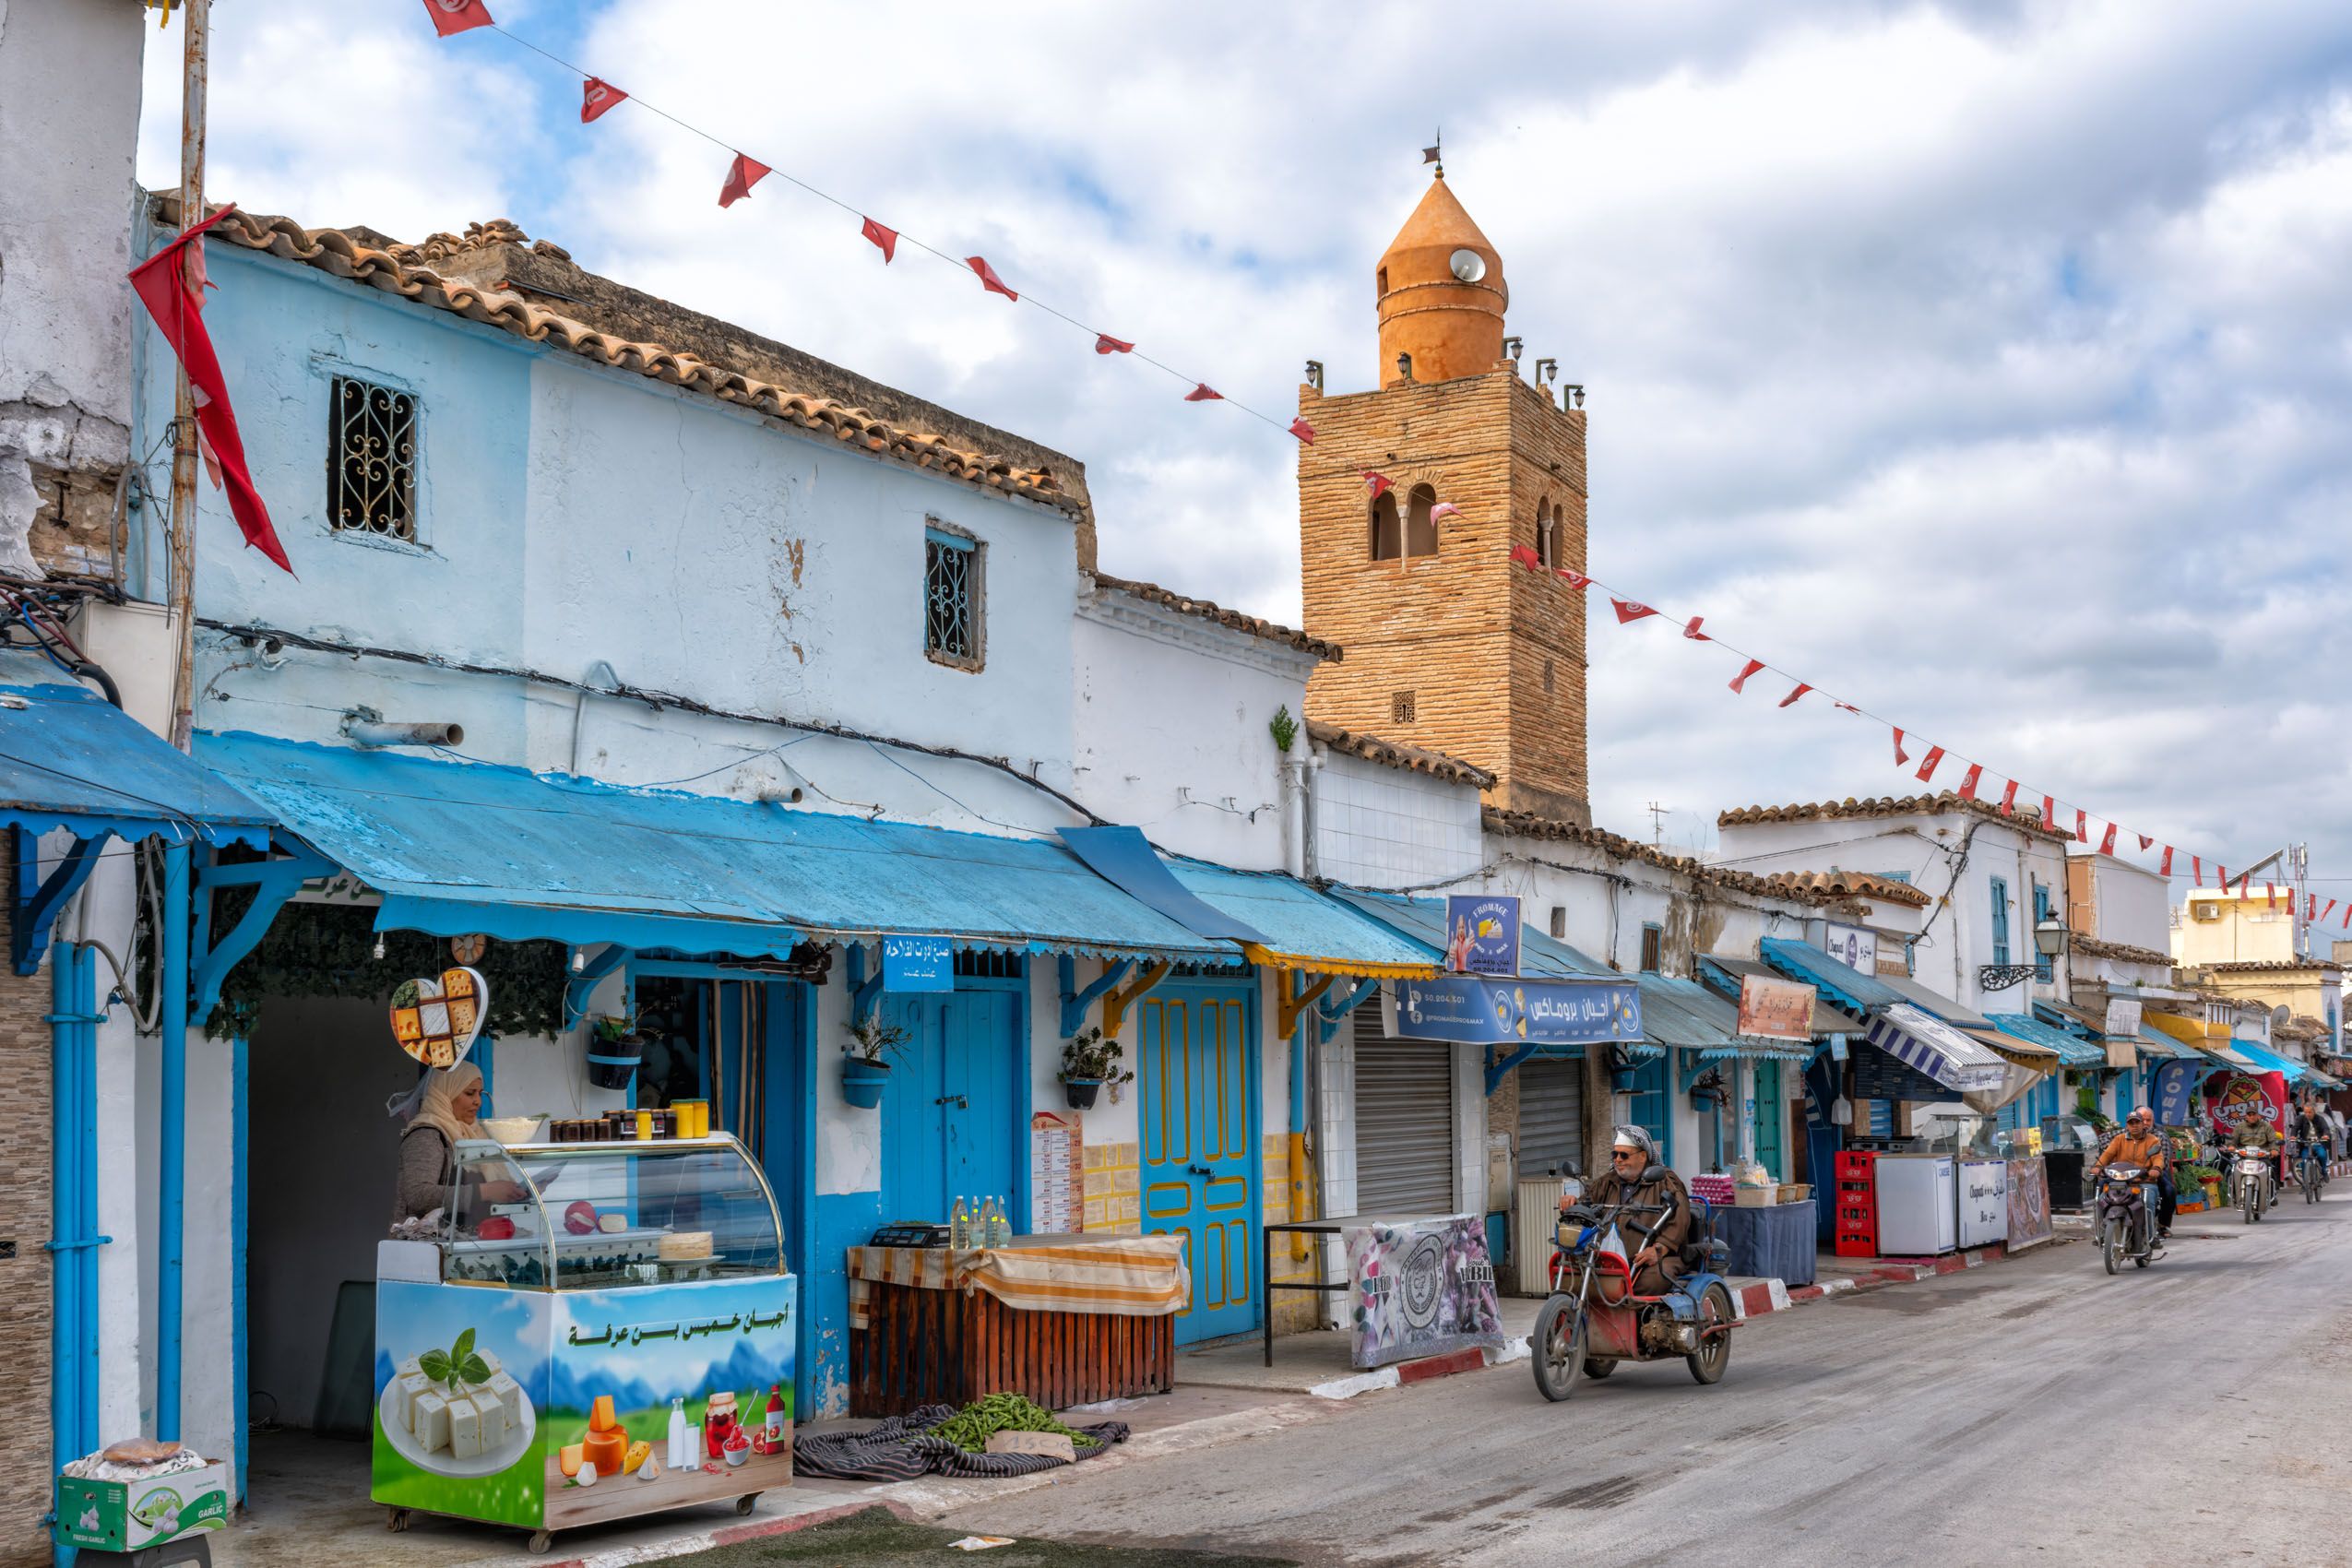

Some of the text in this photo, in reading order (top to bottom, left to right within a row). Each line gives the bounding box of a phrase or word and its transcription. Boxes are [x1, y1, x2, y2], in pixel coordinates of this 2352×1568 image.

[1473, 903, 1509, 918] FROMAGE
[1475, 943, 1485, 954] PRO
[1496, 943, 1509, 955] MAX
[1425, 994, 1465, 1004] 50.204401
[1530, 992, 1609, 1021] أجبان بروماكس
[568, 1302, 789, 1348] أجبان خميس بن عرفة
[197, 1504, 223, 1519] GARLIC
[73, 1534, 105, 1544] FRESH GARLIC
